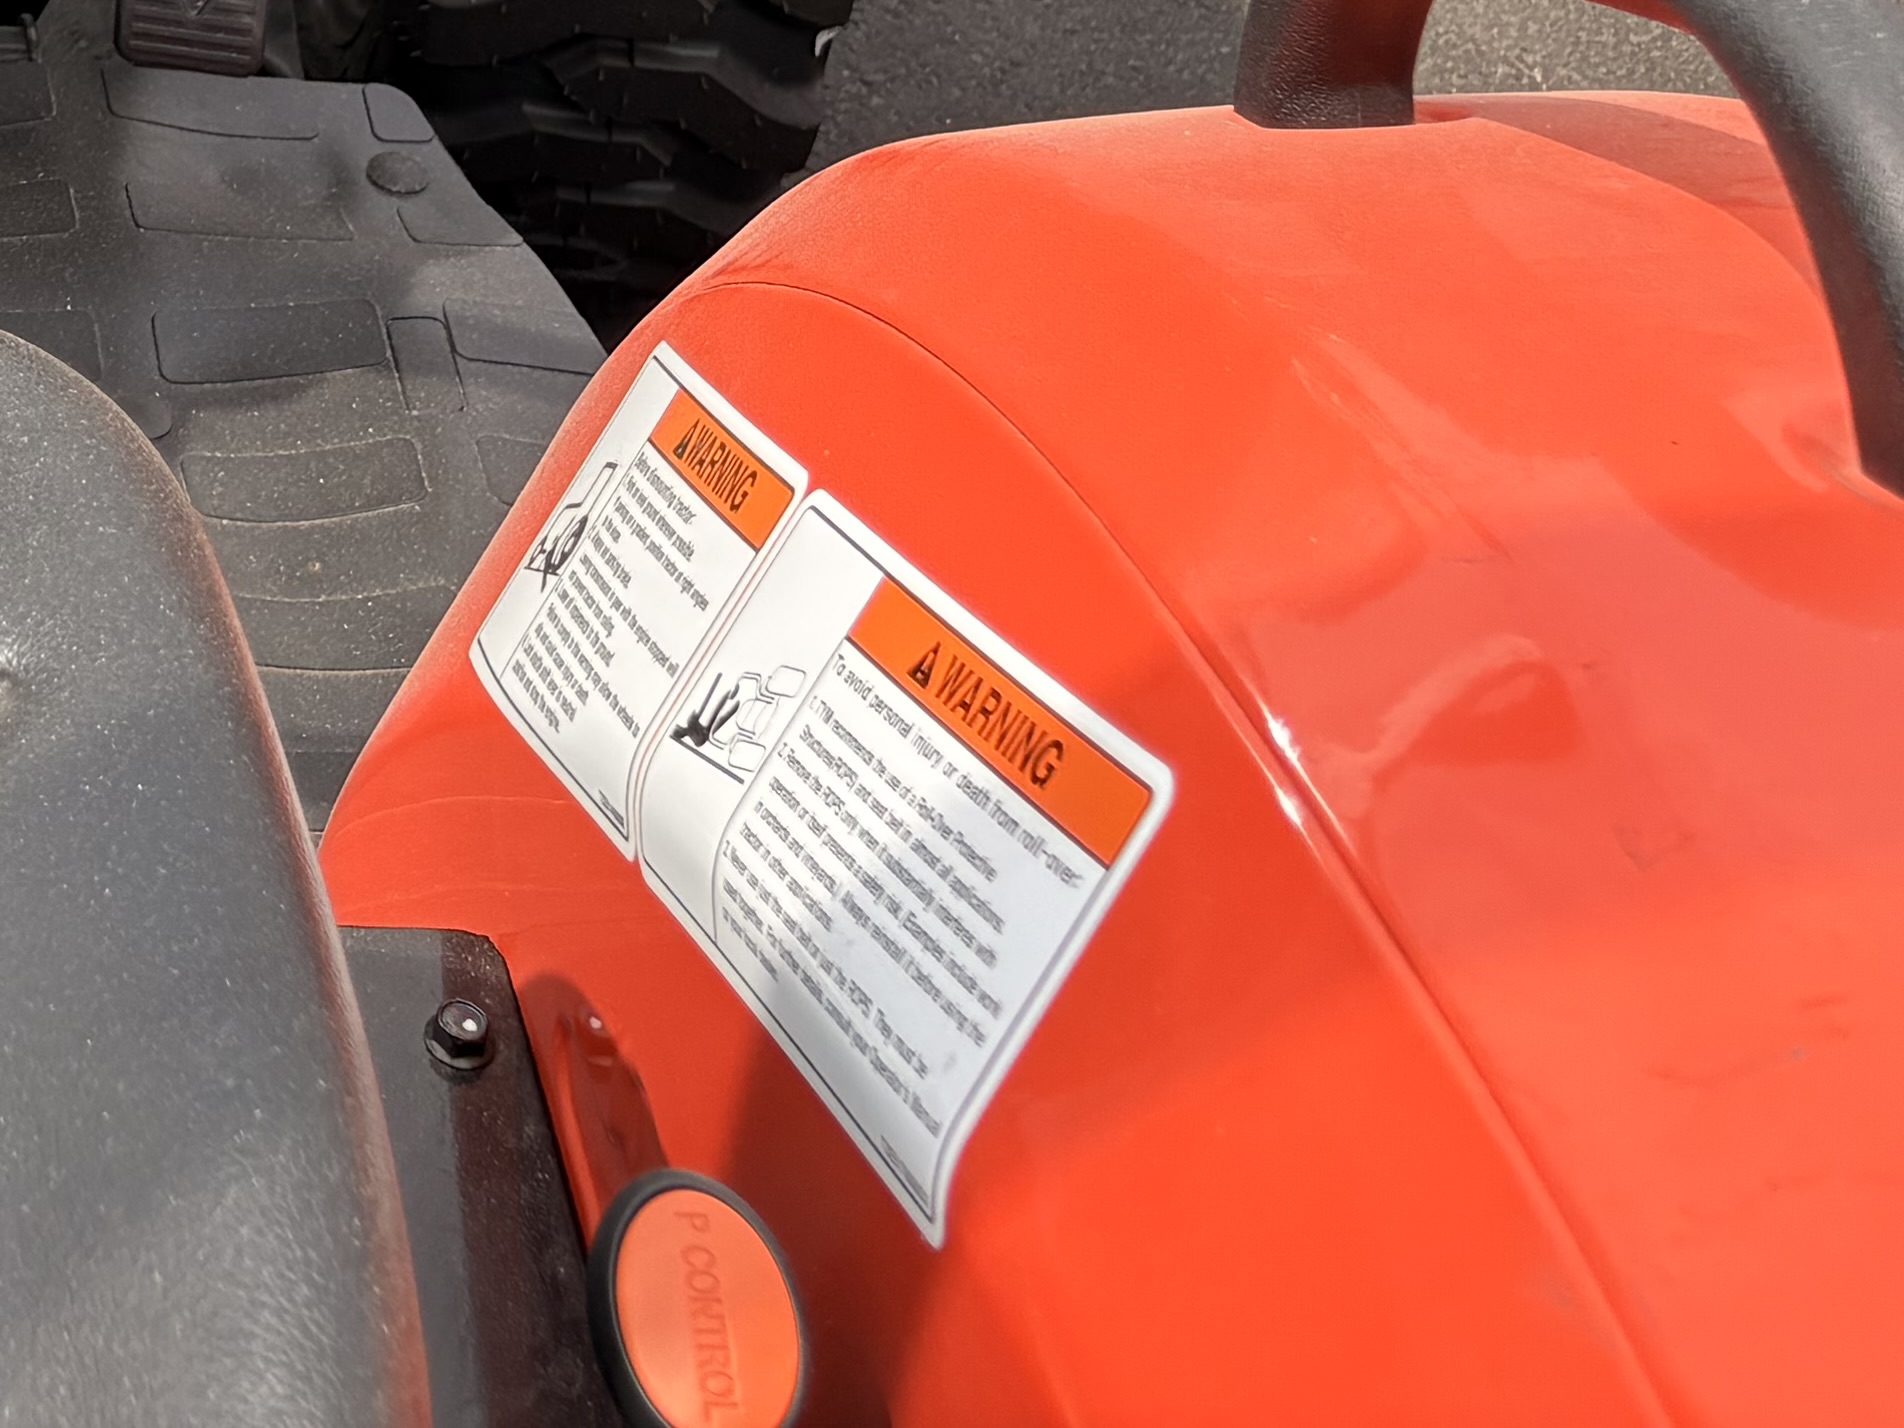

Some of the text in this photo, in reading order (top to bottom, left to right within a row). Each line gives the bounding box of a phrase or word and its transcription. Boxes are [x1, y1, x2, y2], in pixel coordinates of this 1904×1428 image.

[682, 422, 759, 518] WARNING
[831, 653, 847, 677] To
[843, 664, 874, 702] avoid
[867, 688, 915, 744] personal
[909, 726, 945, 771] injury
[942, 758, 959, 782] or
[955, 767, 993, 812] death
[988, 797, 1021, 837] from
[933, 653, 1067, 795] WARNING
[674, 1210, 739, 1424] P CONTROL
